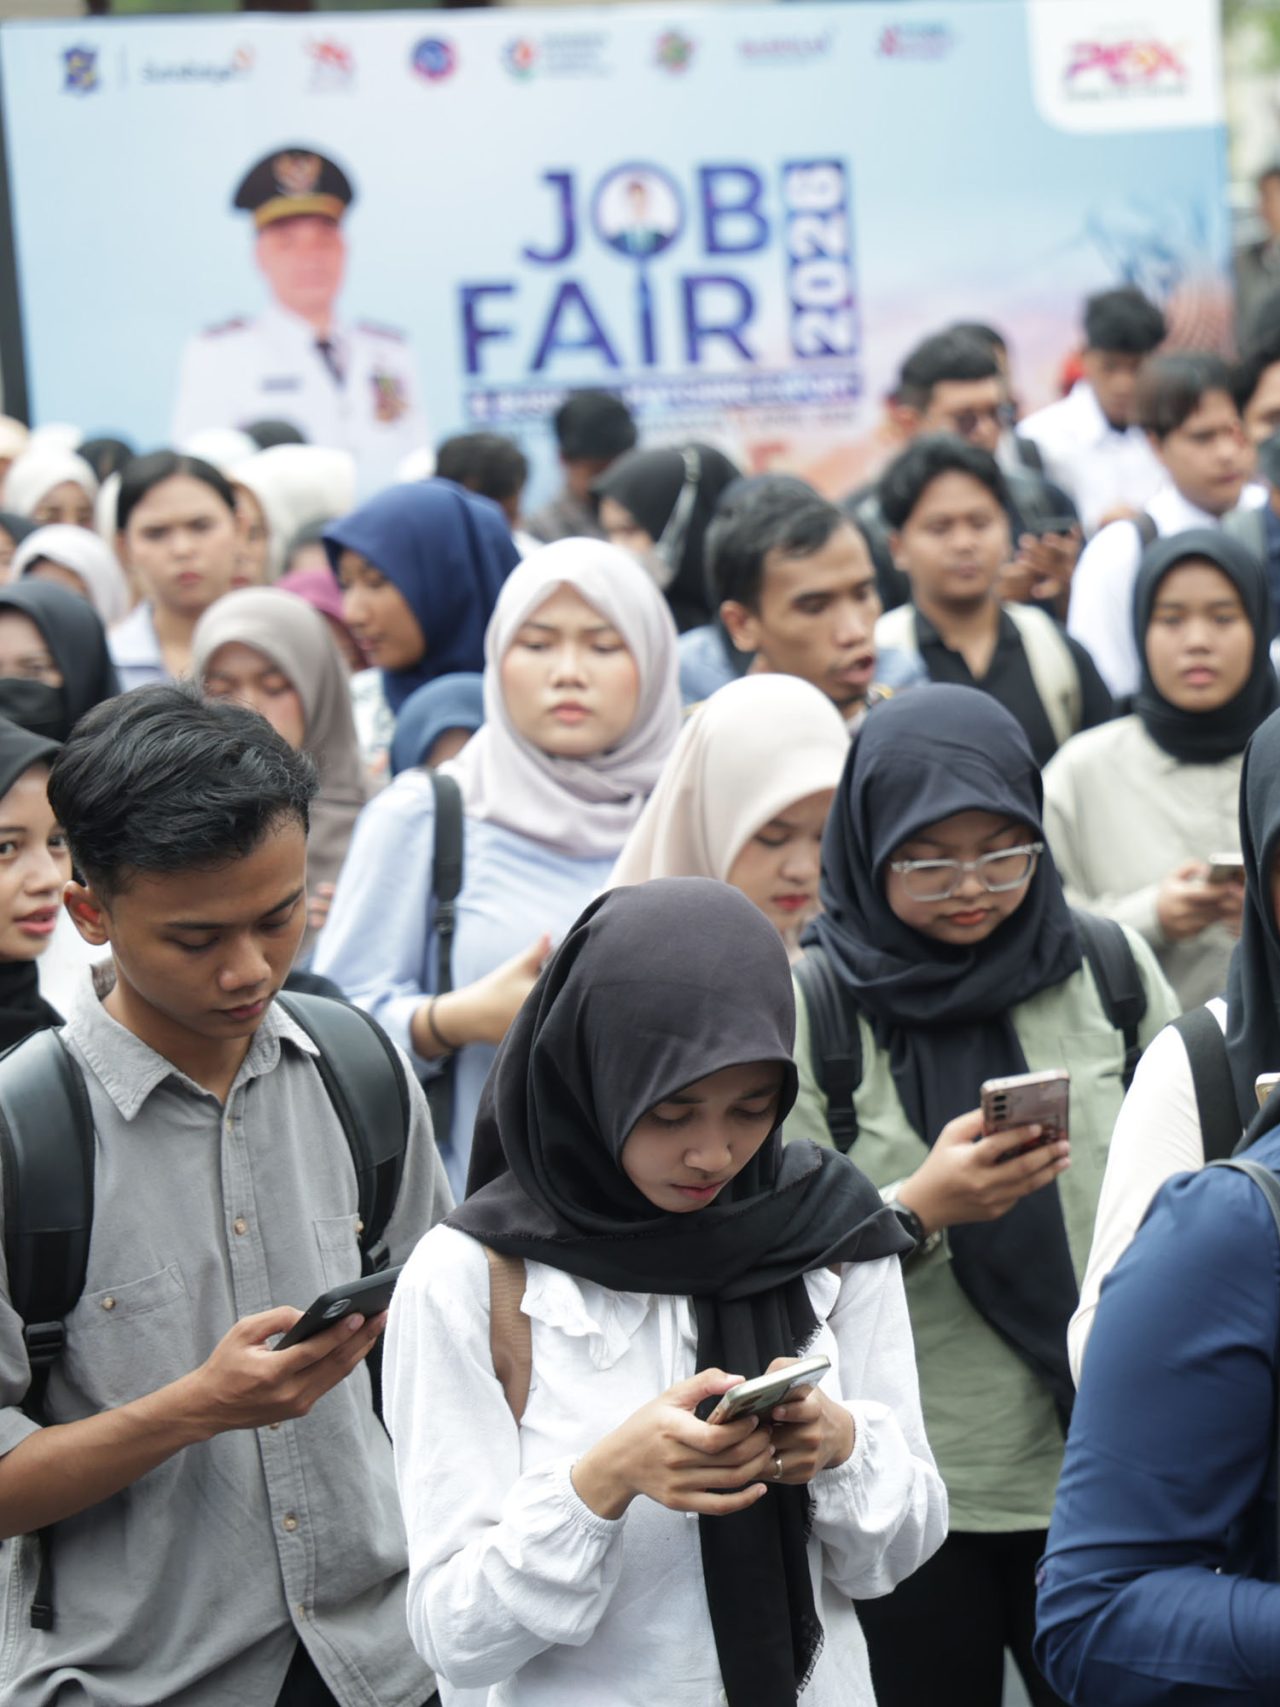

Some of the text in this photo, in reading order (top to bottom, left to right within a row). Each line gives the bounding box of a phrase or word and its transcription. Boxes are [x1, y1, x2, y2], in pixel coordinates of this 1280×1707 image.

[522, 162, 770, 264] JOB
[784, 164, 855, 358] 2026
[459, 274, 757, 376] FAIR
